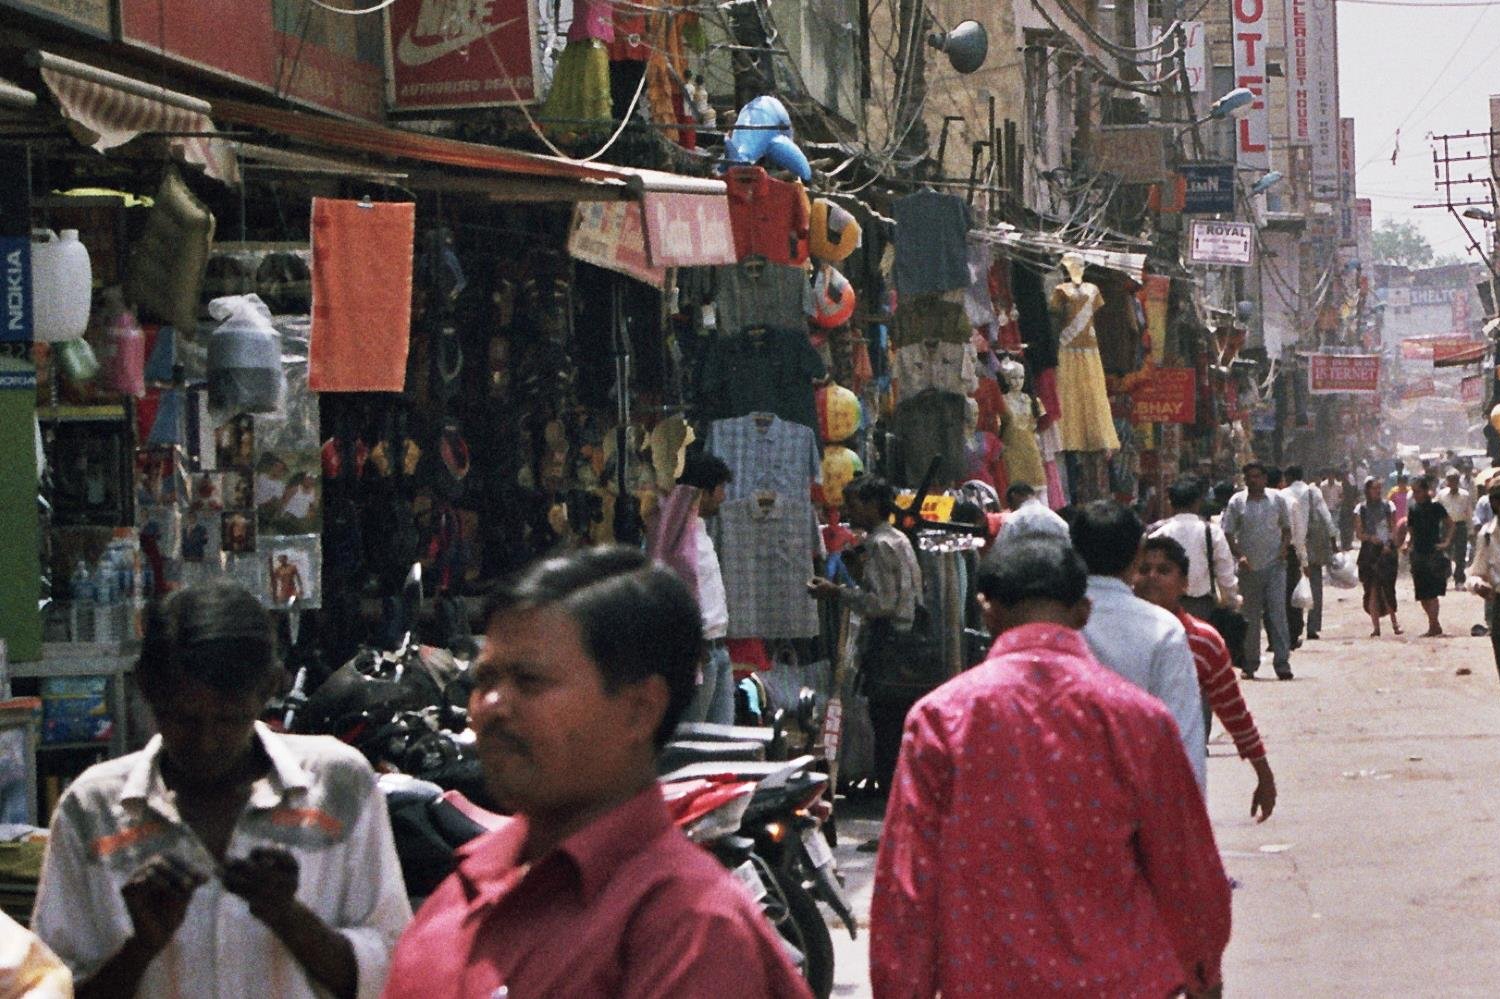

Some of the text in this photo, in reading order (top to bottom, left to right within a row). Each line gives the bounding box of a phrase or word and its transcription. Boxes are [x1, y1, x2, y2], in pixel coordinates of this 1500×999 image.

[1297, 89, 1309, 138] HOUSE
[1206, 223, 1247, 237] ROYAL
[8, 249, 24, 331] NOKIA
[1315, 367, 1376, 380] INTERNET
